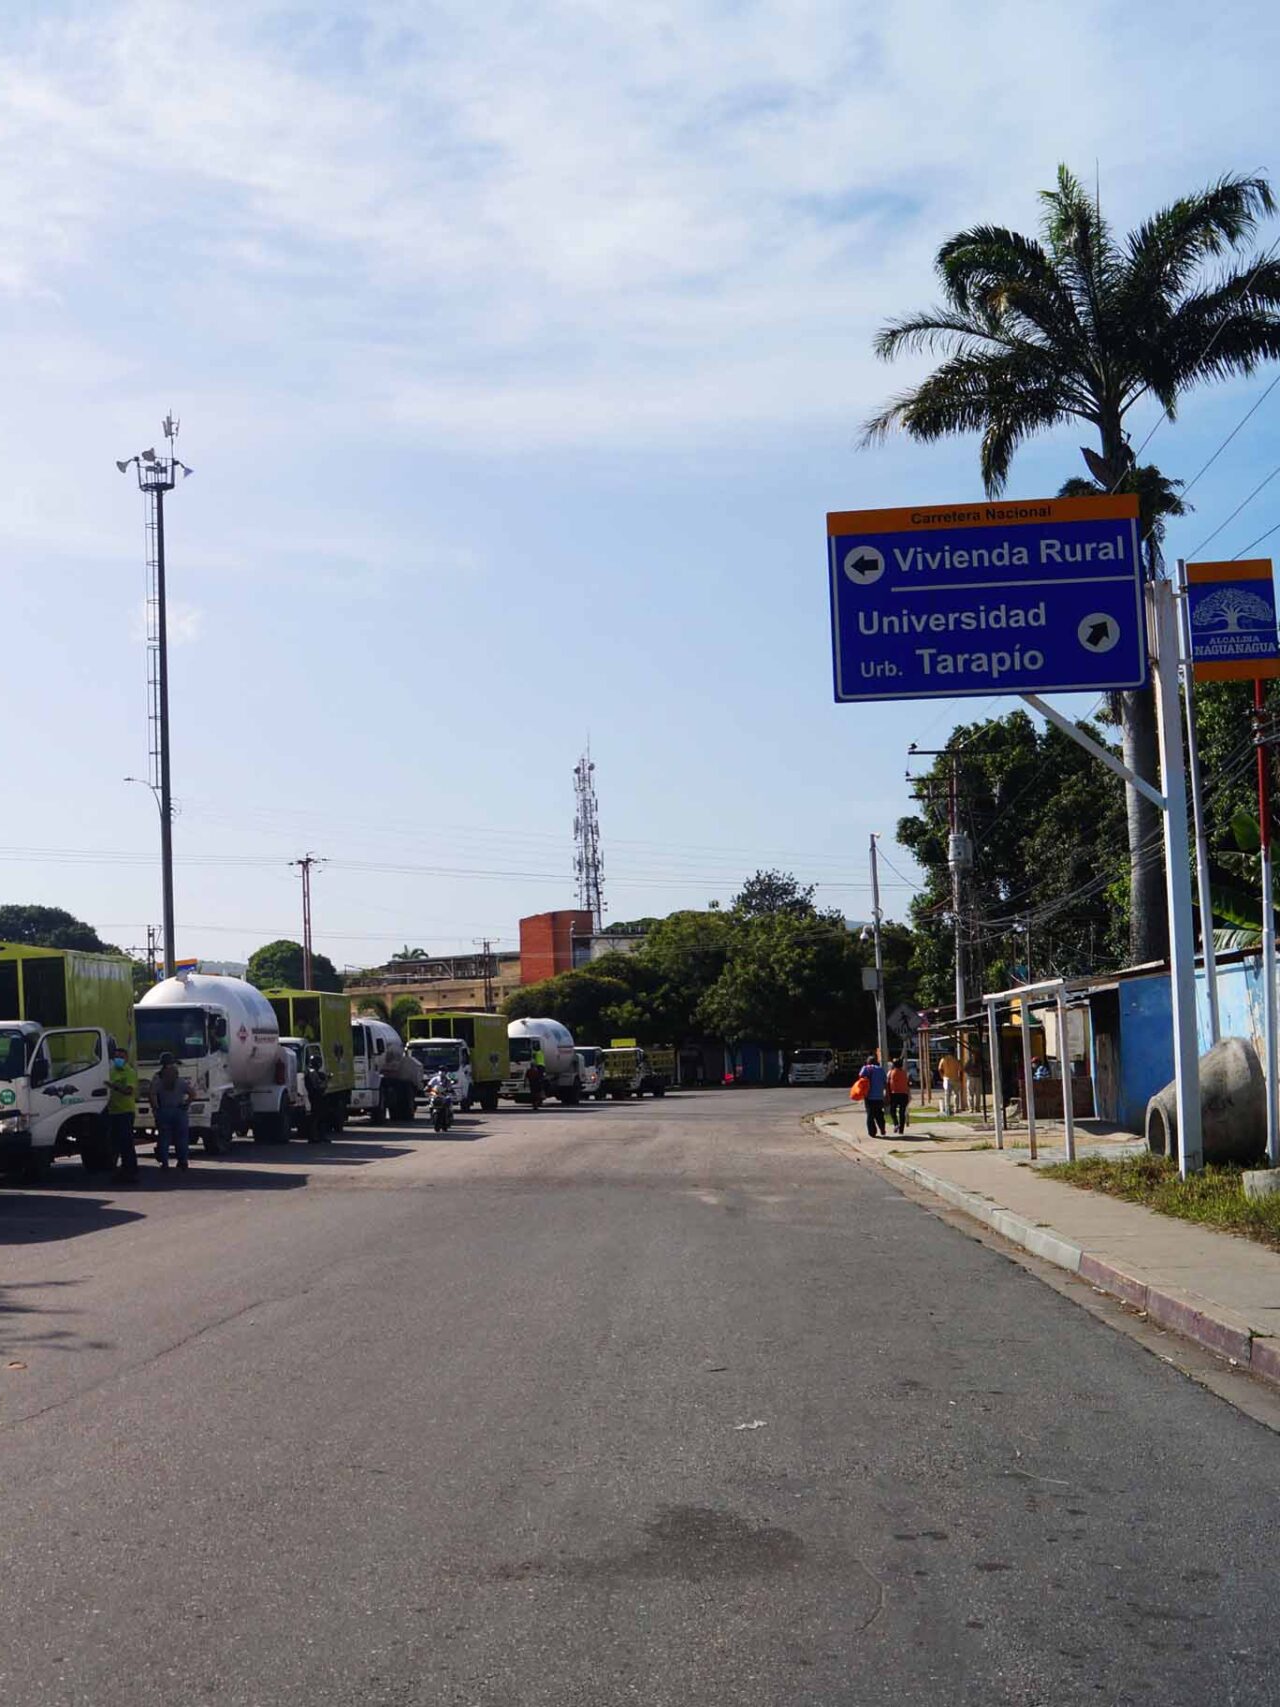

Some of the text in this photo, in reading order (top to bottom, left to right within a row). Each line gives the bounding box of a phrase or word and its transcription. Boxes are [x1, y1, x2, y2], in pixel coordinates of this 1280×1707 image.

[911, 505, 1052, 525] Carretera Nacional
[893, 535, 1124, 572] Vivienda Rural
[858, 601, 1046, 636] Universidad
[860, 643, 1045, 679] Urb. Tarapío
[1194, 642, 1277, 656] NAGUANAGUA
